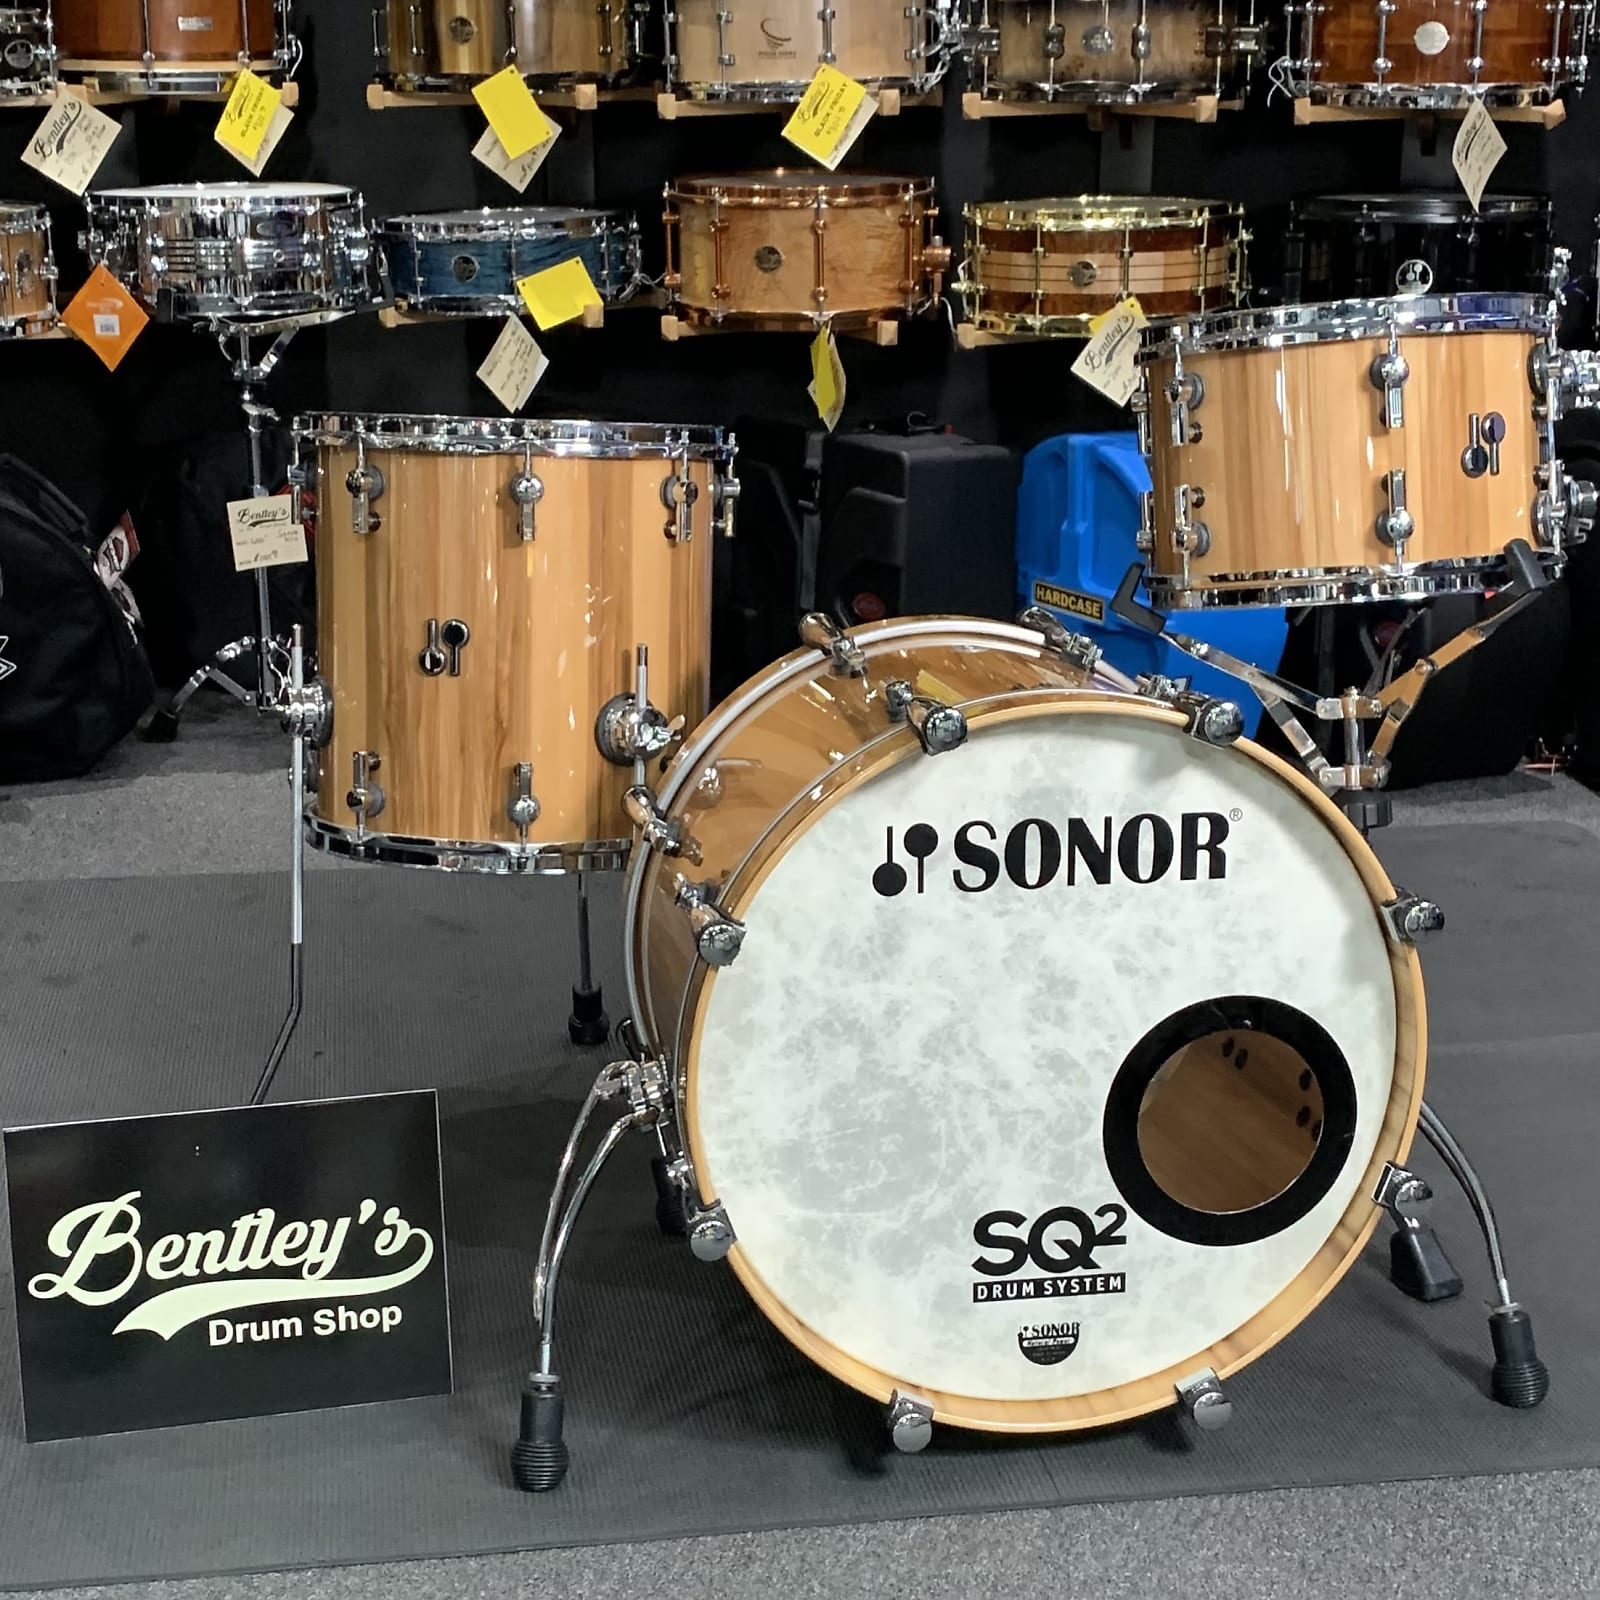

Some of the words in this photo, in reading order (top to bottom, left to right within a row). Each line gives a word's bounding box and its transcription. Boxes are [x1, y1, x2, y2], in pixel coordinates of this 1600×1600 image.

[813, 110, 833, 137] BLACK
[829, 82, 849, 110] FRIDAY
[34, 101, 80, 162] Bentley's
[1084, 314, 1131, 373] Bentley's
[236, 507, 288, 524] Bentley's
[1036, 586, 1101, 617] HARDCASE
[28, 1190, 433, 1306] Bentley's
[976, 1281, 1035, 1300] DRUM
[1043, 1275, 1122, 1295] SYSTEM
[208, 1315, 303, 1347] Drum
[313, 1304, 403, 1337] Shop
[1031, 1321, 1080, 1338] SONOR
